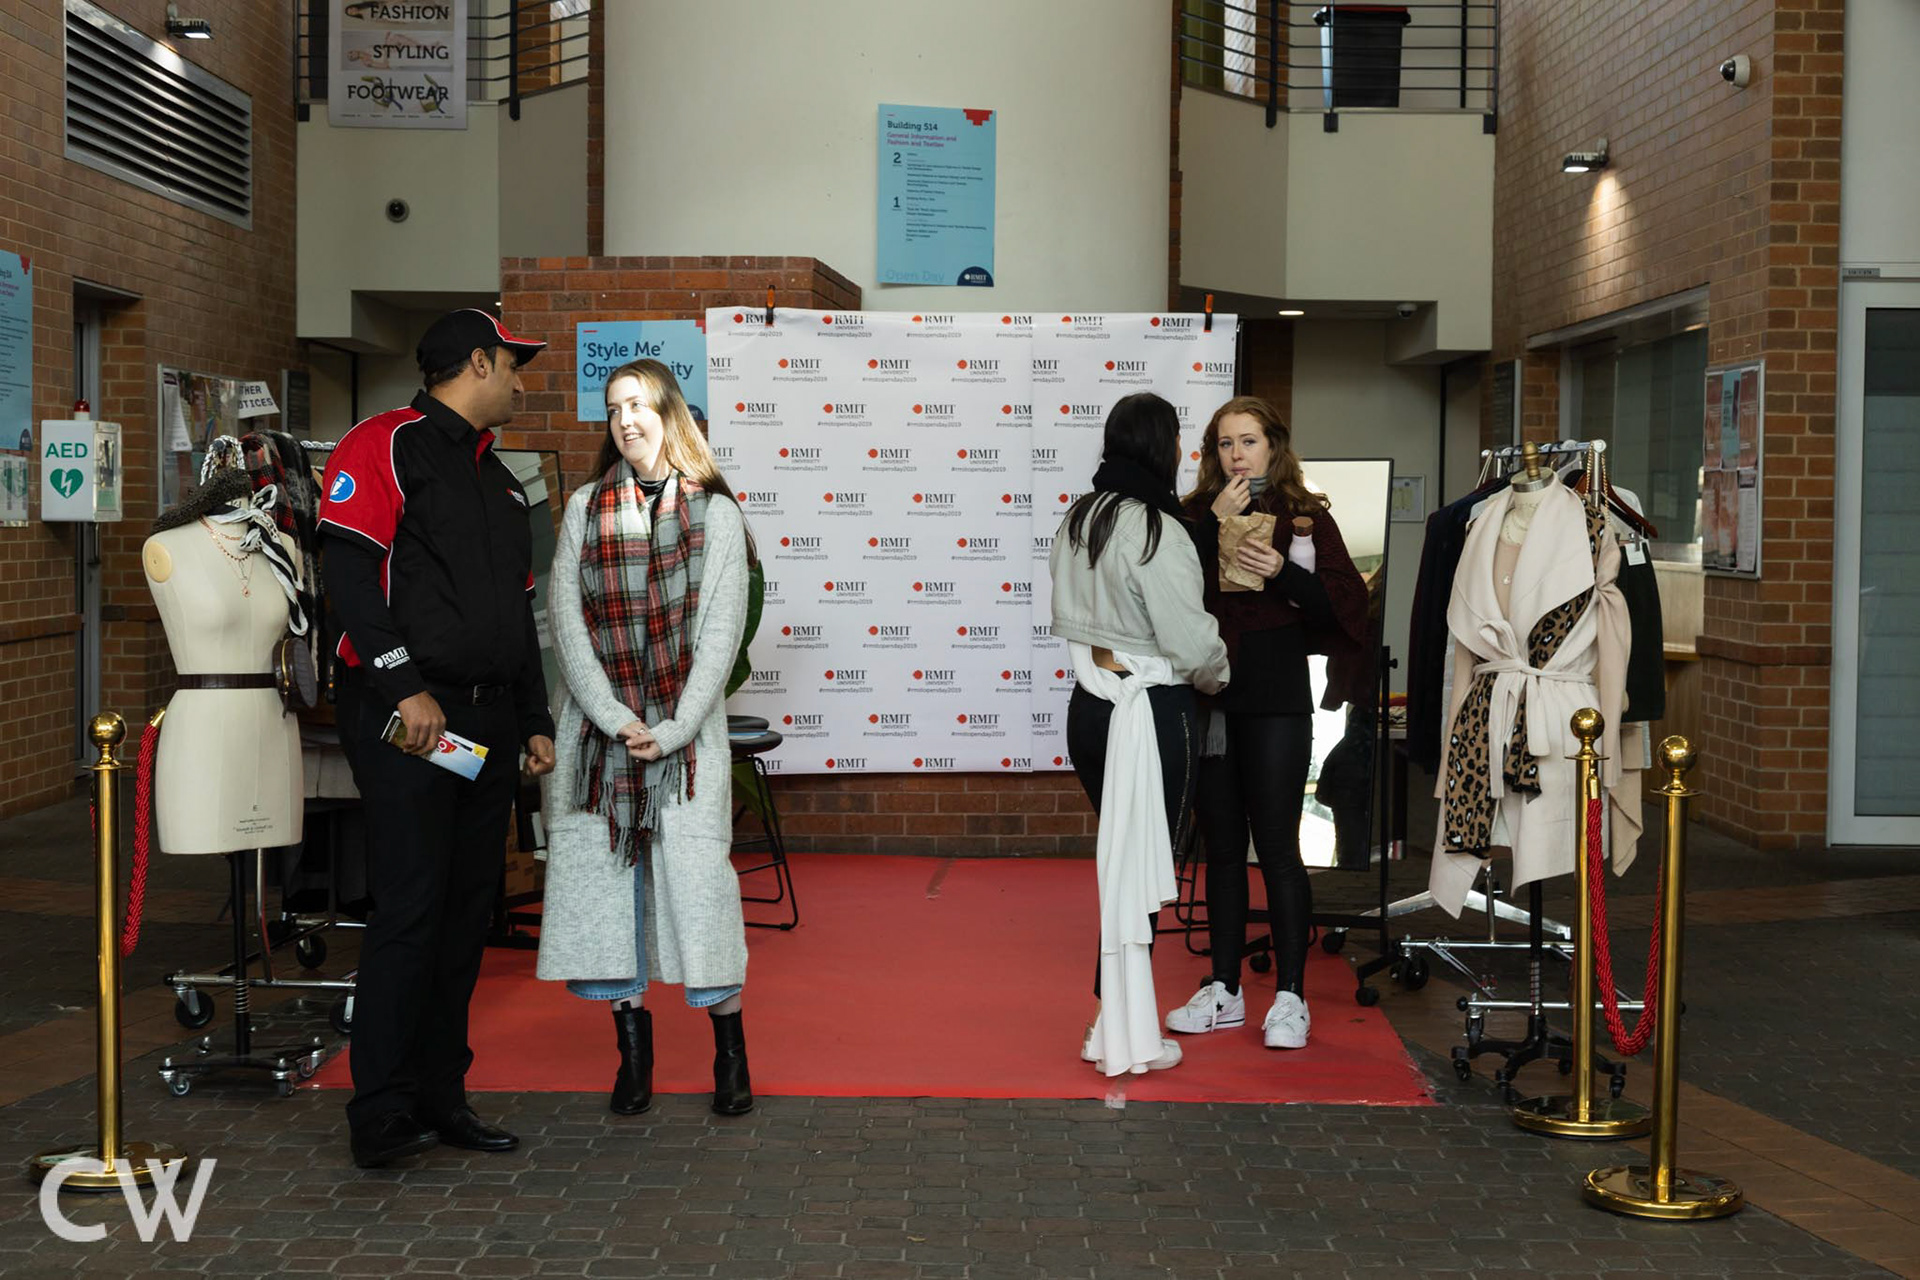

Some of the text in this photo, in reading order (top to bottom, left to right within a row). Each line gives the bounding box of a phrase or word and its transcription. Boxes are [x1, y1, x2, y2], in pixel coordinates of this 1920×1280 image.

[370, 5, 450, 20] FASHION
[373, 45, 449, 60] STYLING
[347, 85, 449, 100] FOOTWEAR
[887, 120, 938, 132] Building 514
[893, 152, 901, 164] 2
[893, 196, 900, 208] 1
[710, 357, 734, 367] MIT
[790, 358, 822, 368] RMIT
[880, 359, 911, 369] RMIT
[970, 360, 1000, 370] RMIT
[1117, 361, 1148, 371] RMIT
[239, 385, 262, 395] THER
[239, 398, 273, 410] OTICES
[747, 402, 778, 412] RMIT
[835, 404, 866, 414] RMIT
[925, 404, 956, 414] RMIT
[1072, 404, 1103, 414] RMIT
[45, 443, 88, 458] AED
[712, 447, 734, 457] MIT
[791, 448, 822, 458] RMIT
[880, 448, 911, 458] RMIT
[969, 449, 1000, 459] RMIT
[748, 492, 779, 502] RMIT
[836, 492, 867, 502] RMIT
[925, 493, 956, 503] RMIT
[792, 537, 822, 547] RMIT
[880, 537, 911, 547] RMIT
[969, 538, 1000, 548] RMIT
[836, 581, 867, 591] RMIT
[925, 582, 956, 592] RMIT
[792, 626, 824, 636] RMIT
[880, 626, 911, 636] RMIT
[969, 626, 1000, 636] RMIT
[381, 646, 408, 665] RMIT
[751, 671, 781, 680] RMIT
[836, 670, 867, 680] RMIT
[925, 670, 956, 680] RMIT
[794, 714, 825, 724] RMIT
[880, 714, 912, 724] RMIT
[969, 714, 1000, 724] RMIT
[1032, 714, 1053, 722] MIT
[836, 758, 868, 768] RMIT
[925, 758, 956, 767] RMIT
